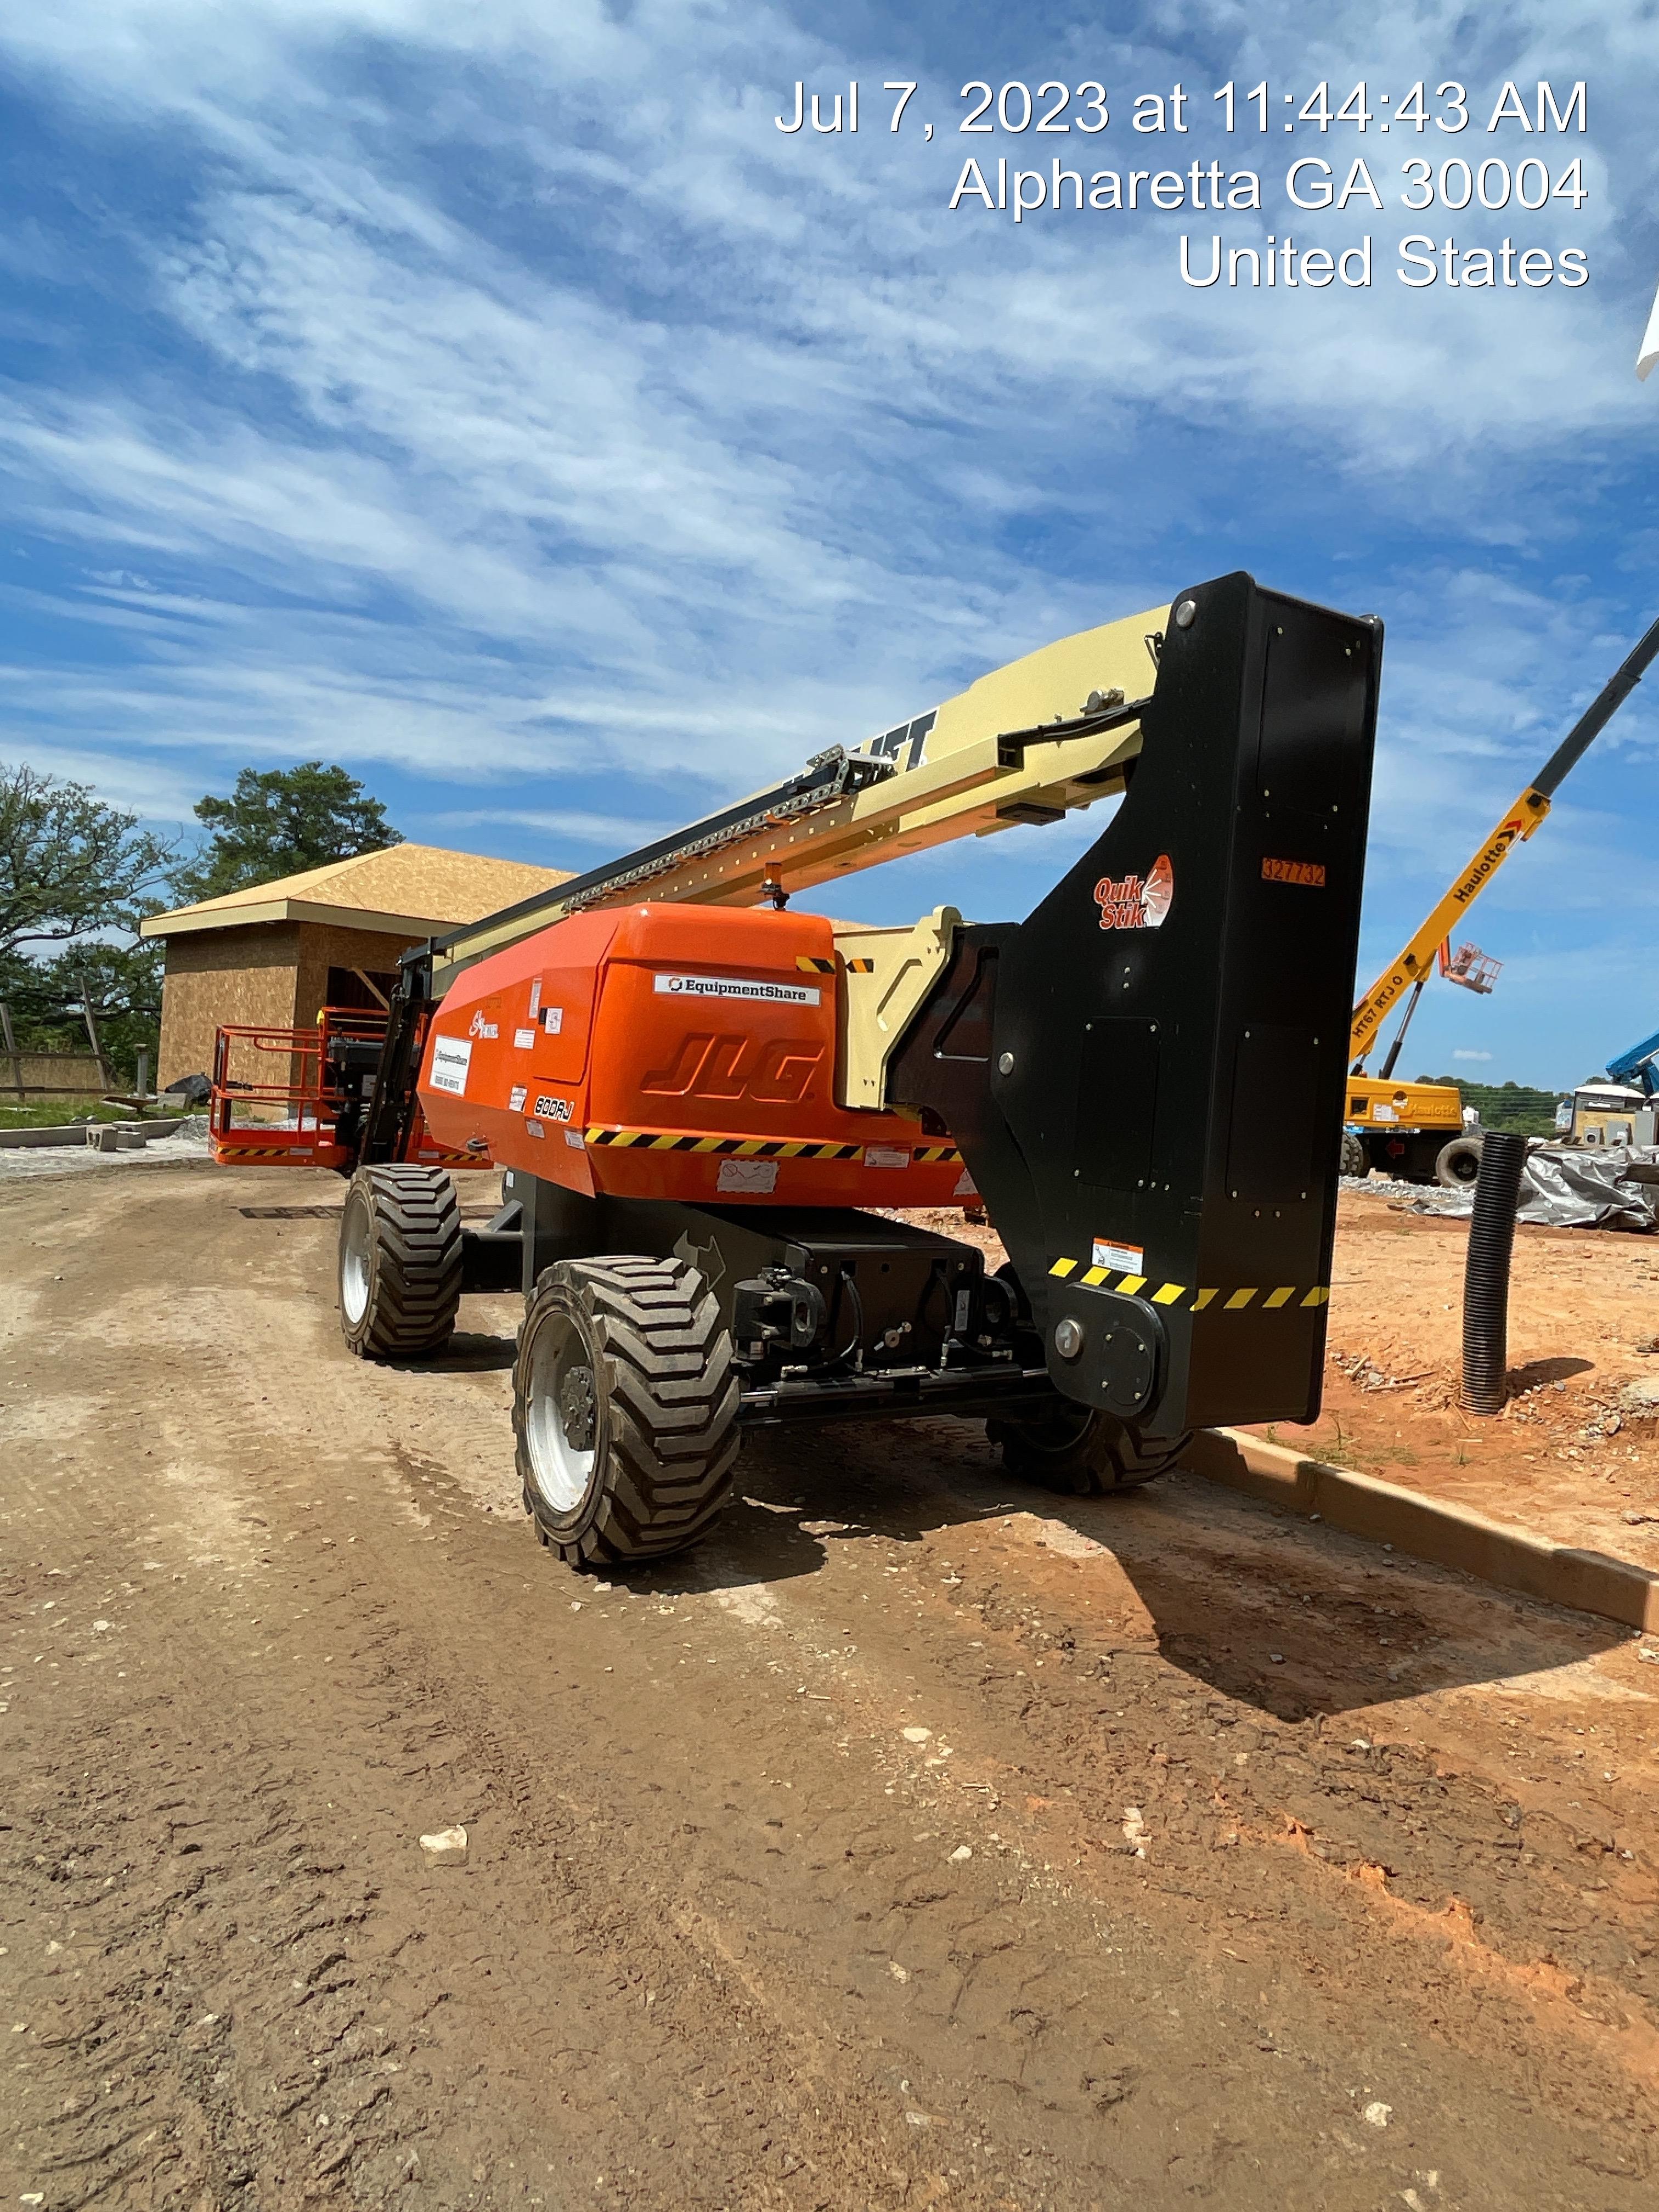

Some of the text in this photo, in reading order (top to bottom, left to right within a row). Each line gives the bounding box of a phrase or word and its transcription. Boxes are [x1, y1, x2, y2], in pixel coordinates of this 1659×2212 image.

[1094, 875, 1144, 906] Quik
[1453, 843, 1506, 903] Haulotte
[1099, 902, 1147, 929] Stik
[685, 979, 807, 1001] EquipmentShare
[1352, 1008, 1377, 1038] HT67
[1374, 985, 1396, 1008] RTJ
[639, 1032, 825, 1104] JLG
